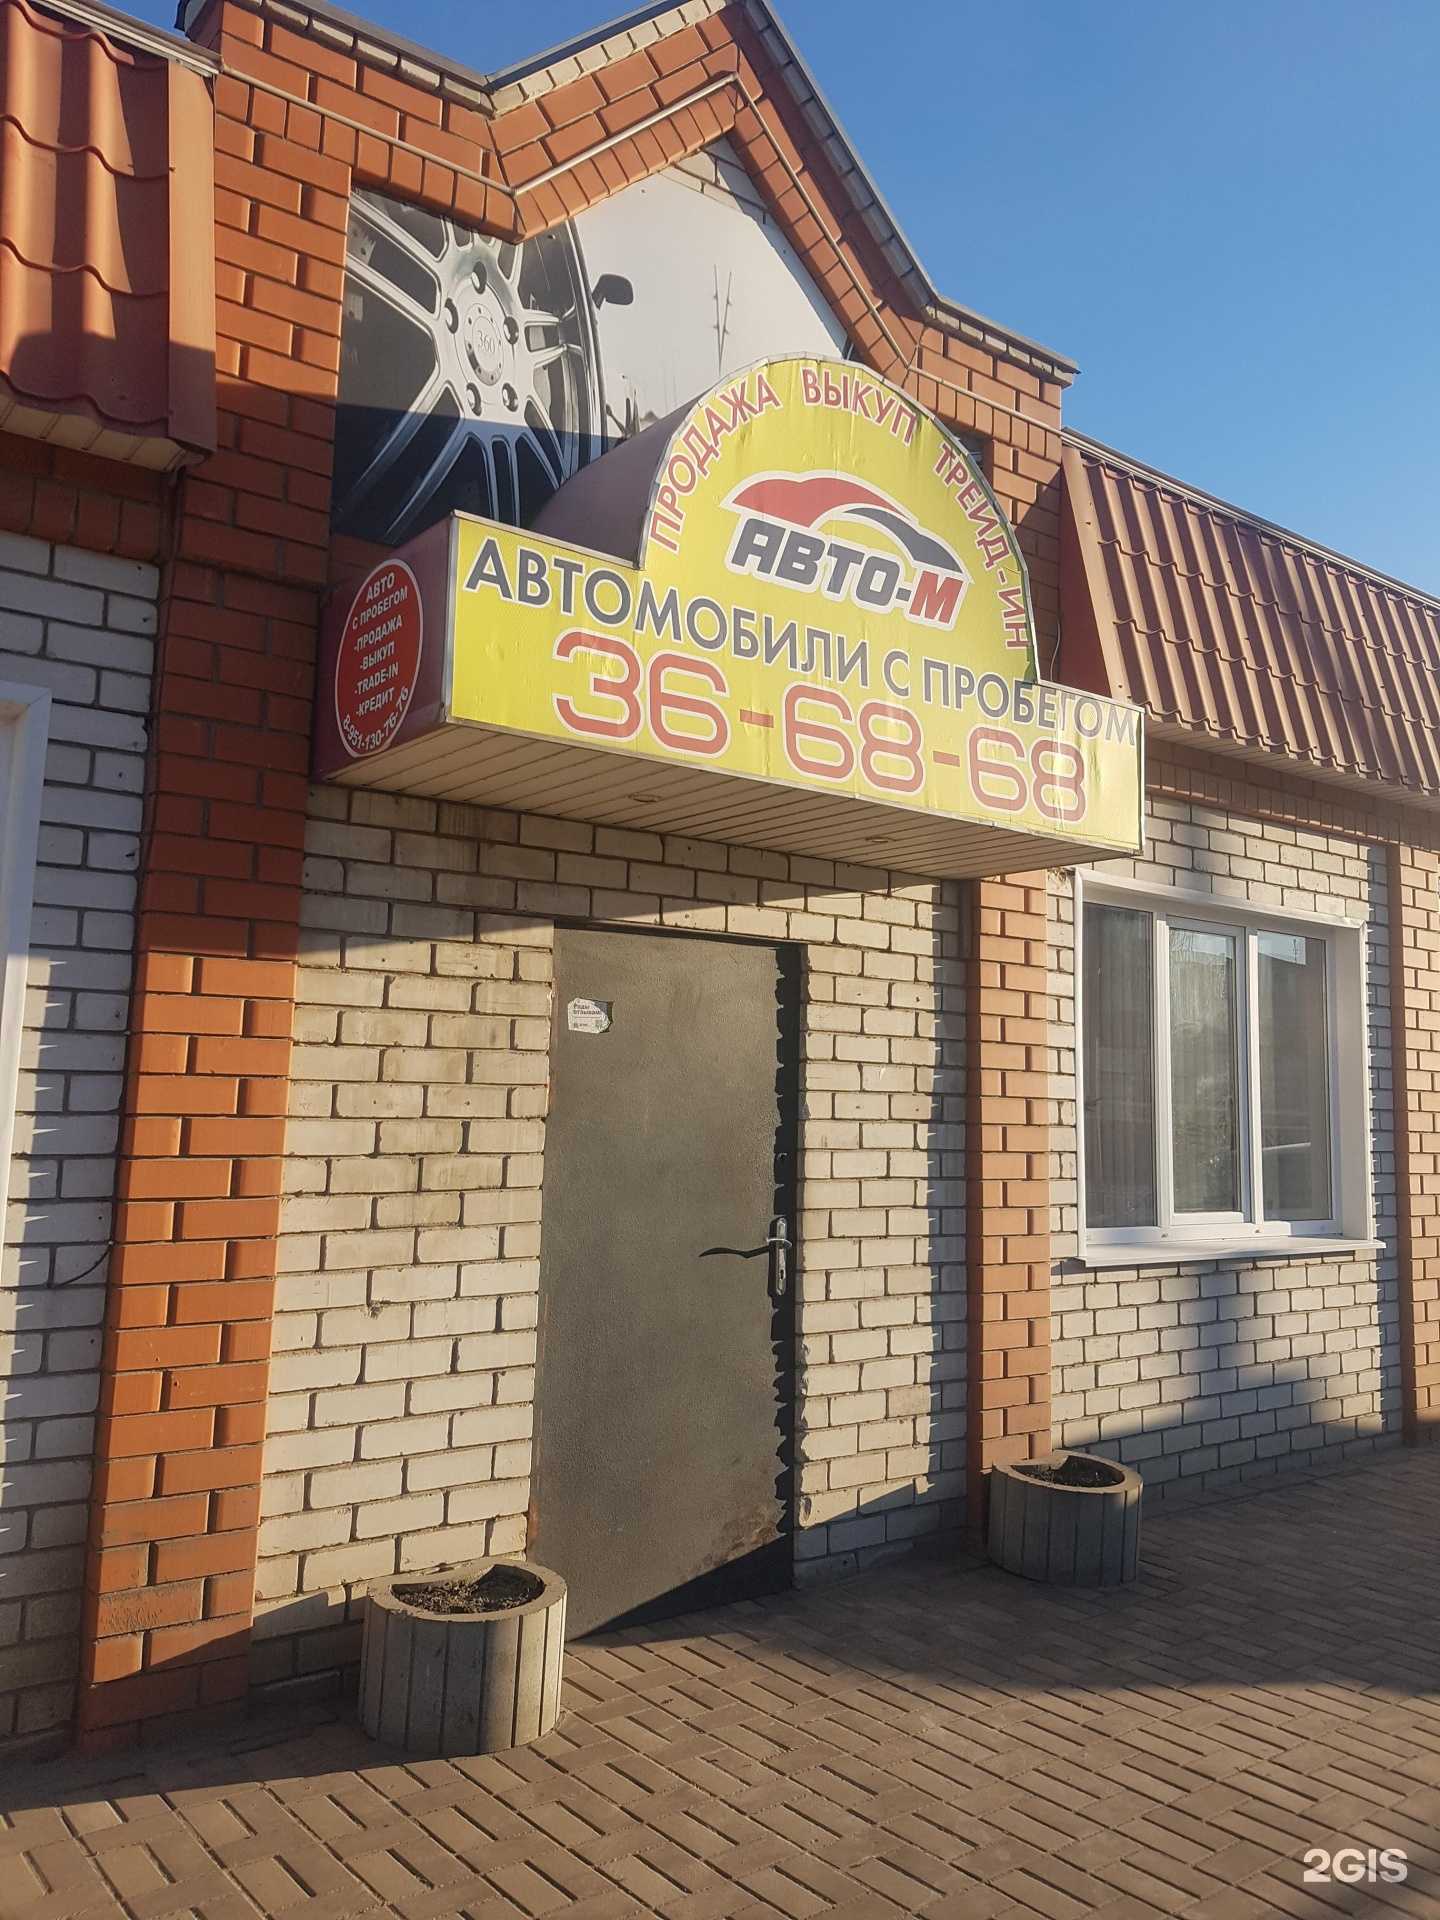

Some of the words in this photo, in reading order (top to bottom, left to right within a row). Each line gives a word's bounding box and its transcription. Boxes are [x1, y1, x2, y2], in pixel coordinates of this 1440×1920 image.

[650, 373, 781, 551] ПРОДАЖА
[801, 367, 917, 443] ВЫКУП
[366, 571, 395, 603] АВТО
[731, 517, 964, 625] АВТО-М
[352, 616, 359, 630] С
[360, 585, 408, 625] ПРОБЕГОМ
[353, 614, 402, 651] -ПРОДАЖА
[465, 537, 870, 687] АВТОМОБИЛИ
[883, 650, 910, 697] С
[923, 657, 1136, 746] ПРОБЕГОМ
[354, 661, 399, 695] -TRADE-IN
[359, 640, 395, 671] -ВЫКУП
[343, 686, 409, 750] 8-951-130-76-76
[356, 686, 395, 717] -КРЕДИТ
[555, 630, 1087, 823] 36-68-68
